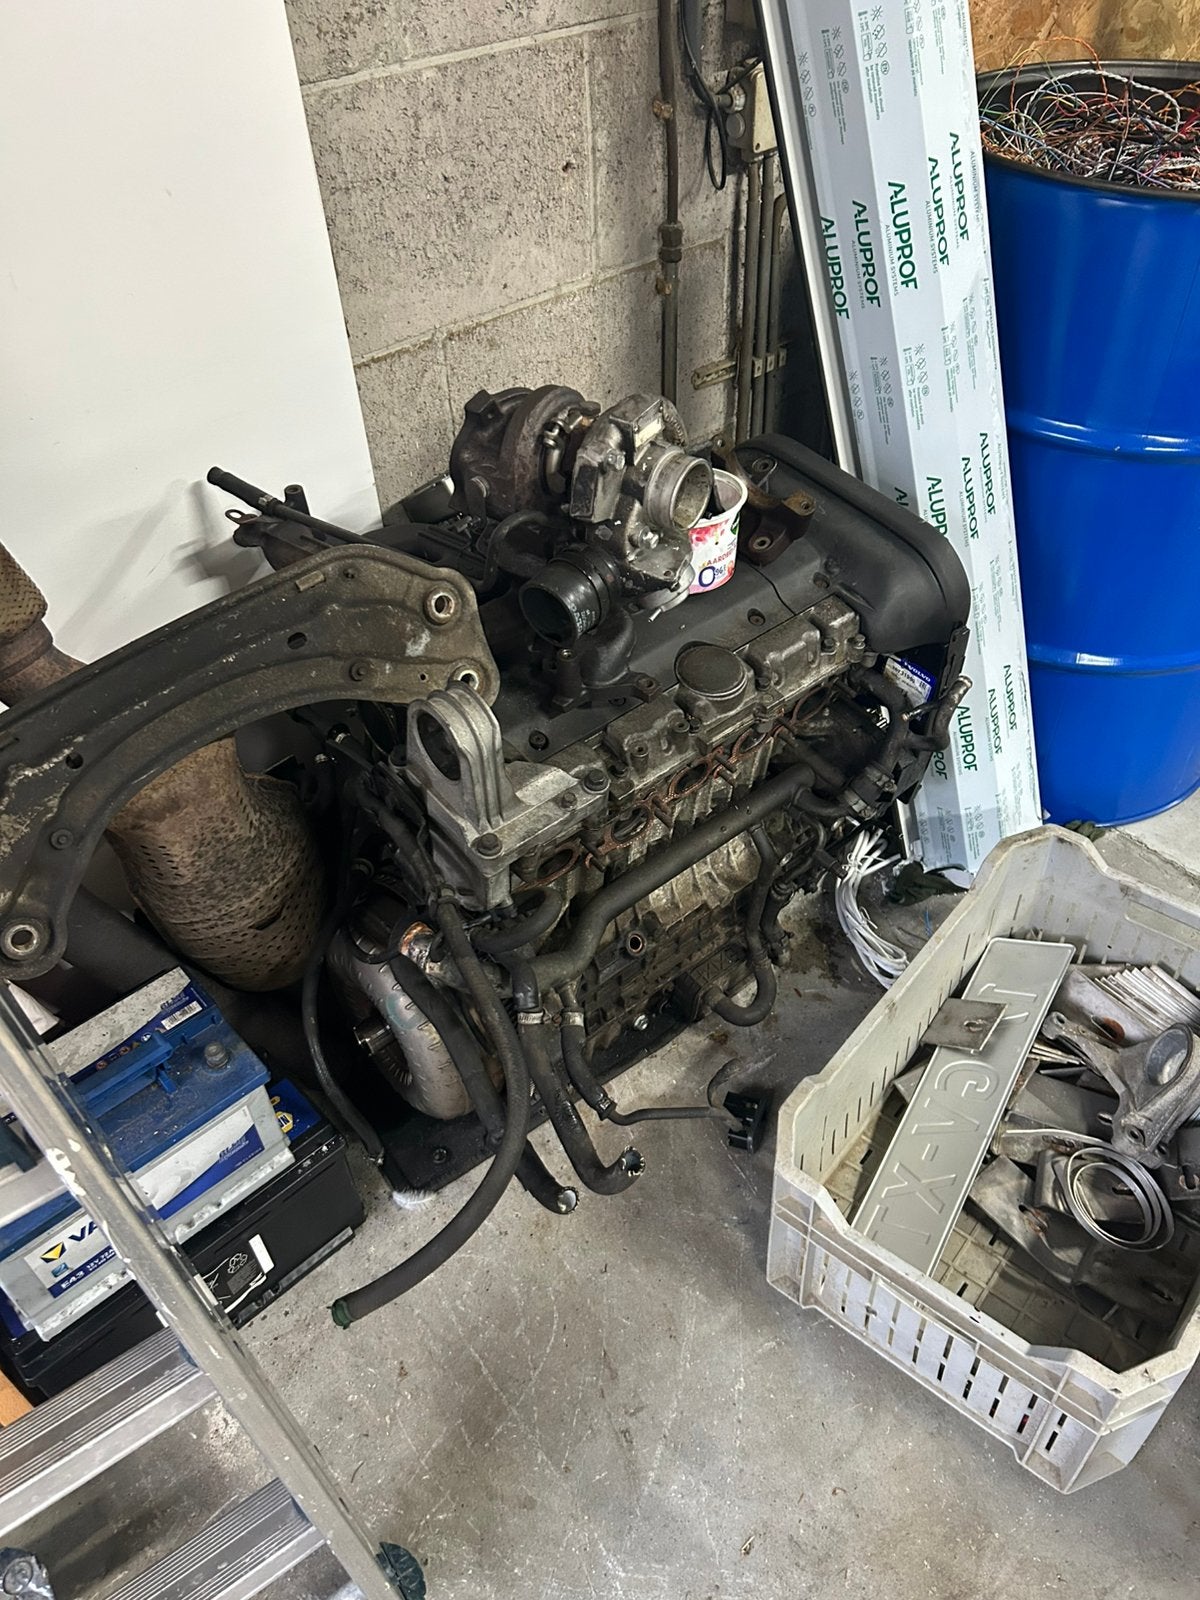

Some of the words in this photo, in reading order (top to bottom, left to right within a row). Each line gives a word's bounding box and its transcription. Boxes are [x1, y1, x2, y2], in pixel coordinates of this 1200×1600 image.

[928, 157, 949, 266] ALUPROF
[949, 132, 969, 241] ALUPROF
[852, 200, 881, 308] ALUPROF
[885, 224, 895, 266] ALUMINIUM
[888, 181, 918, 289] ALUPROF
[925, 200, 935, 243] ALUMINIUM
[820, 215, 850, 320] ALUPROF
[851, 240, 861, 282] ALUMINIUM
[857, 282, 866, 309] SYSTEMS
[926, 476, 948, 536] ALUPR
[961, 457, 979, 540] ALUPROF
[979, 432, 996, 515] ALUPROF
[907, 664, 931, 682] VOLVO
[1003, 664, 1018, 730] ALUPROF
[957, 705, 978, 771] ALUPROF
[988, 688, 1003, 754] ALUPROF
[61, 1270, 85, 1289] E43
